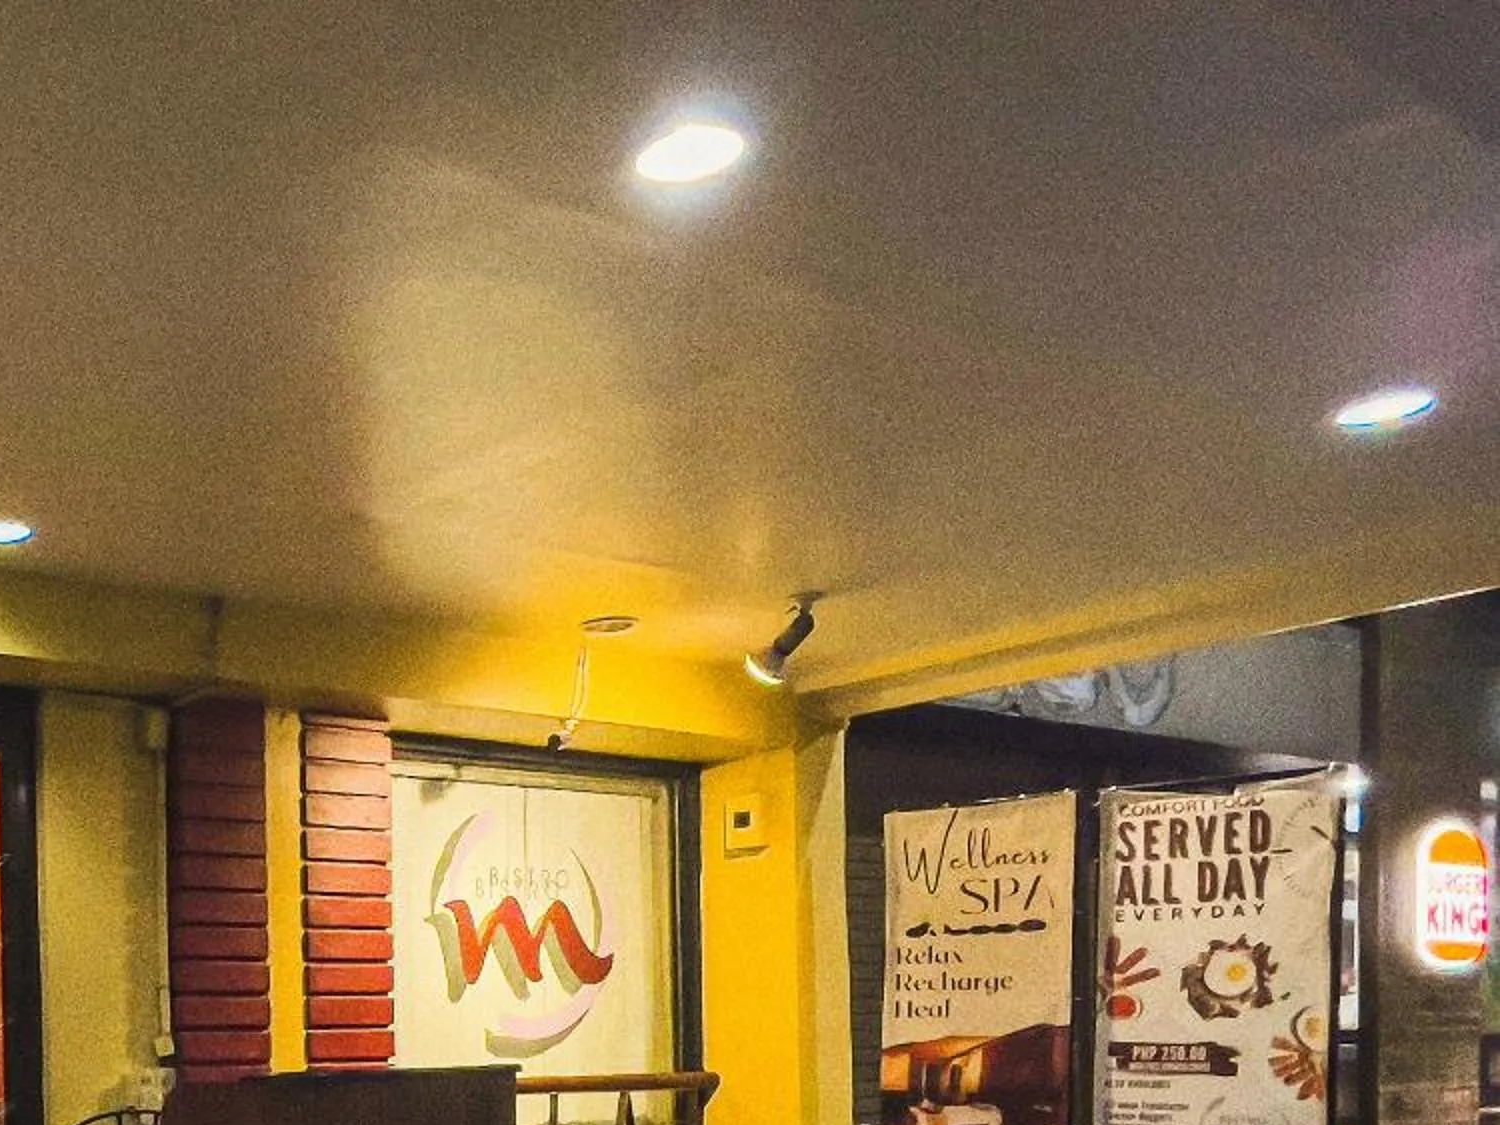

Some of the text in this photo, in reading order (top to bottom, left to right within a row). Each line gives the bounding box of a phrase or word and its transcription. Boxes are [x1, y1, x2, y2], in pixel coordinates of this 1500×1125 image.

[1118, 799, 1207, 818] COMFORT
[1115, 808, 1272, 862] SERVED
[903, 809, 1054, 894] Wellness
[960, 874, 1055, 916] SPA
[1115, 854, 1271, 907] ALL DAY
[1115, 902, 1266, 924] EVERYDAY
[1426, 903, 1483, 936] KING
[896, 945, 964, 966] Relax
[895, 971, 1014, 996] Recharge
[894, 999, 951, 1019] Heal
